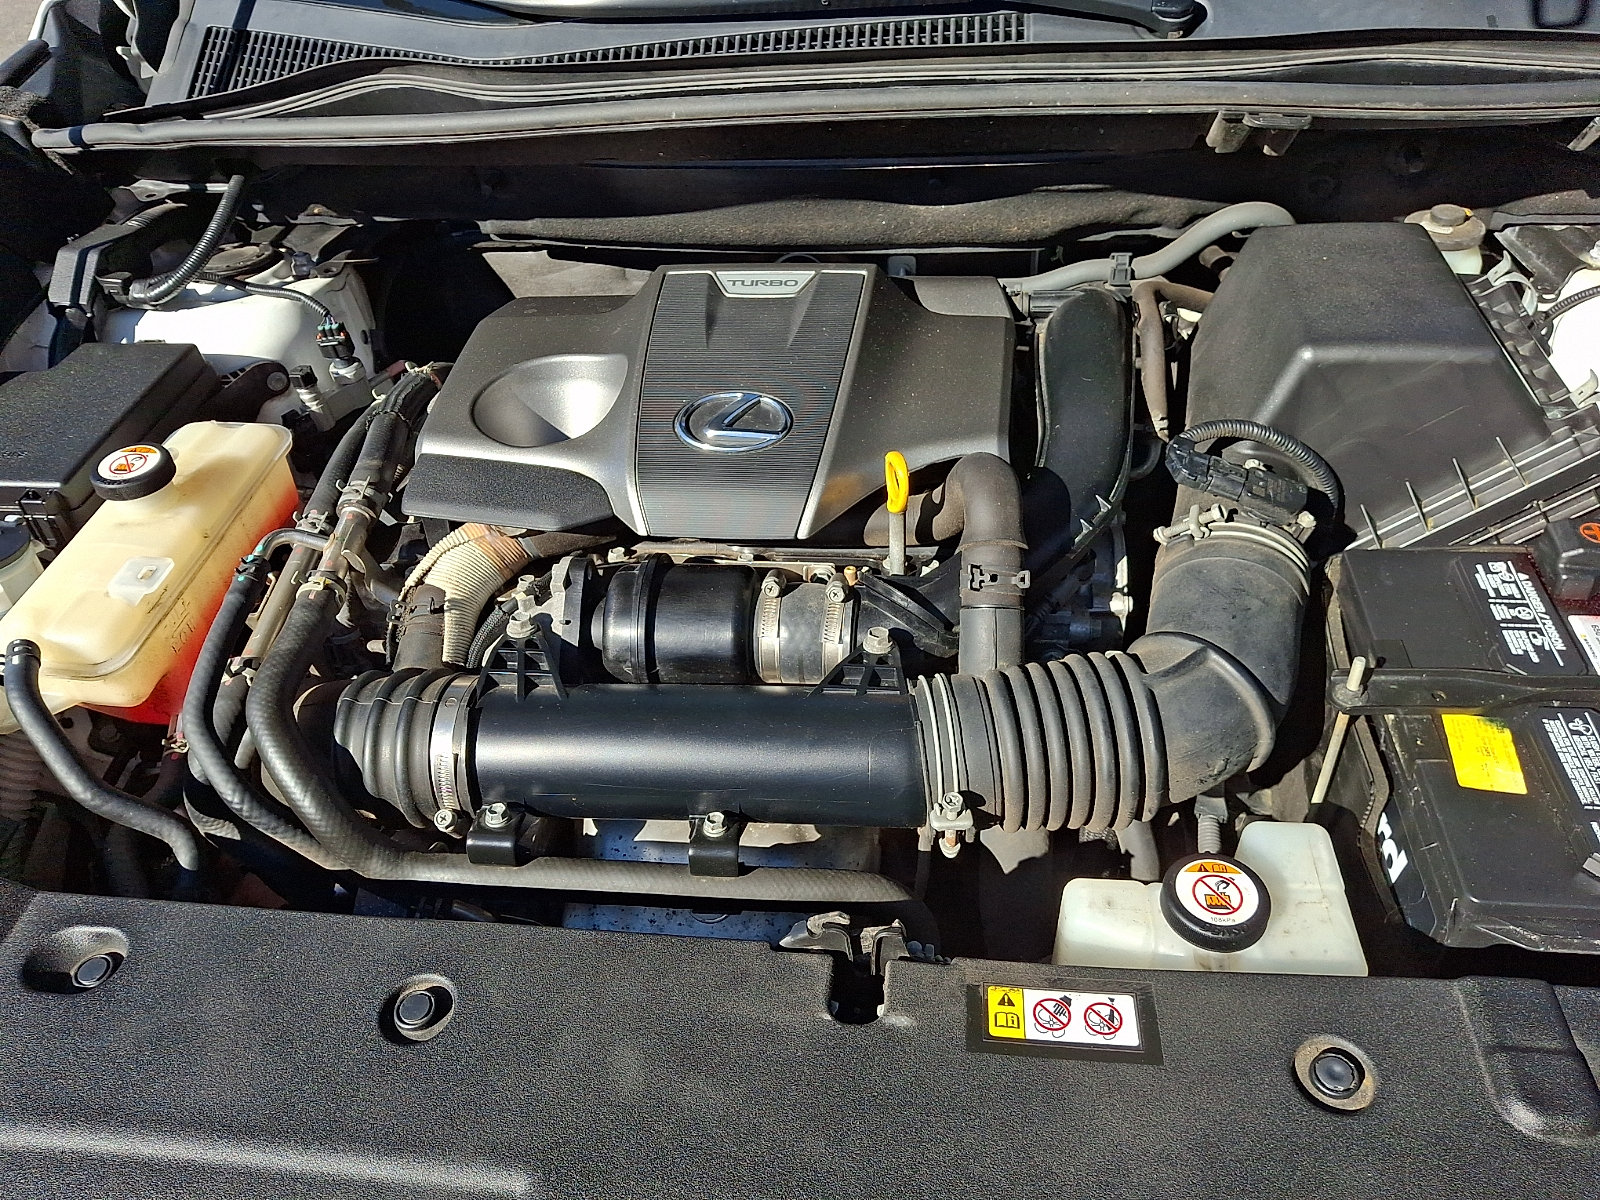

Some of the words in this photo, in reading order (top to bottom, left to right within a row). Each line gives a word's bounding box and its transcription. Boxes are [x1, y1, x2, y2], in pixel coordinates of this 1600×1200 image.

[727, 279, 799, 287] TURBO
[1520, 580, 1546, 612] DANGER
[1541, 619, 1566, 649] POISON
